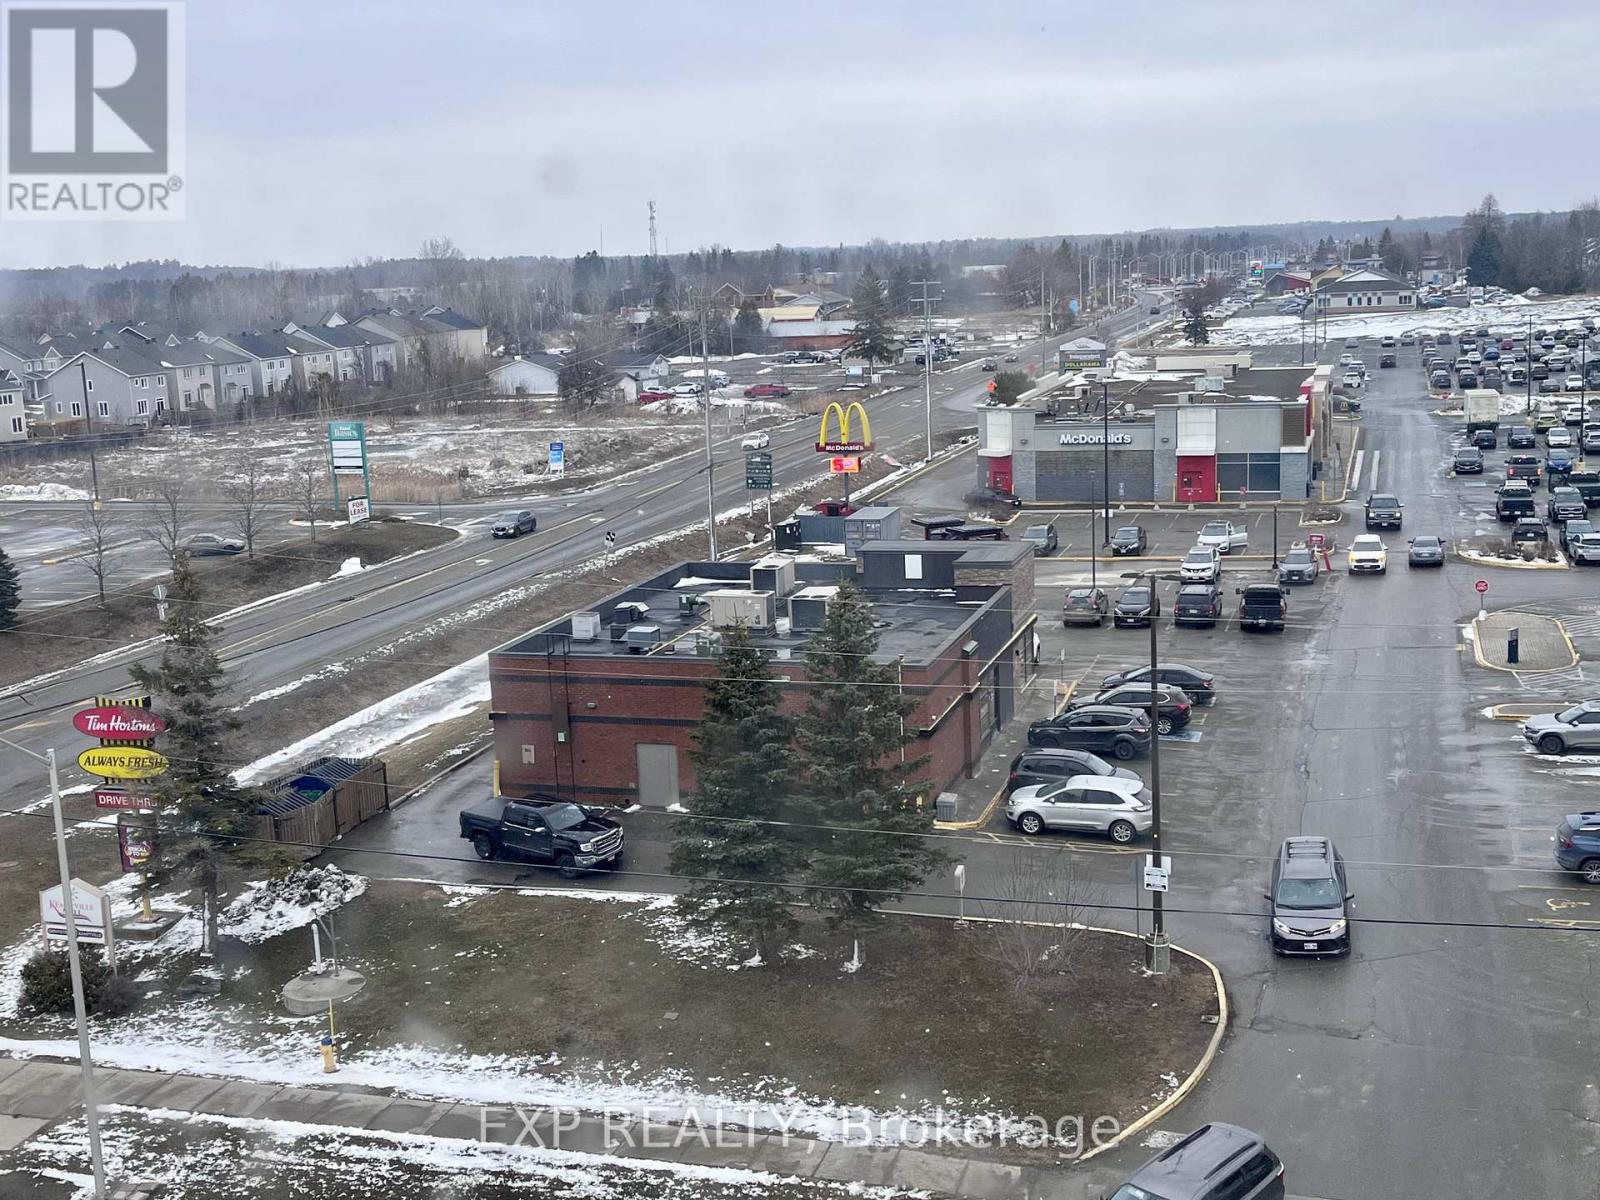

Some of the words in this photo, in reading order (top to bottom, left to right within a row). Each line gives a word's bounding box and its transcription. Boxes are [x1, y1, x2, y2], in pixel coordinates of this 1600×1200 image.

[1060, 433, 1131, 444] McDonald's
[350, 507, 367, 516] LEASE
[85, 715, 107, 731] Tim
[109, 714, 156, 732] Hortons
[83, 755, 125, 768] ALWAYS
[126, 756, 164, 769] FRESH
[98, 795, 129, 806] DRIVE
